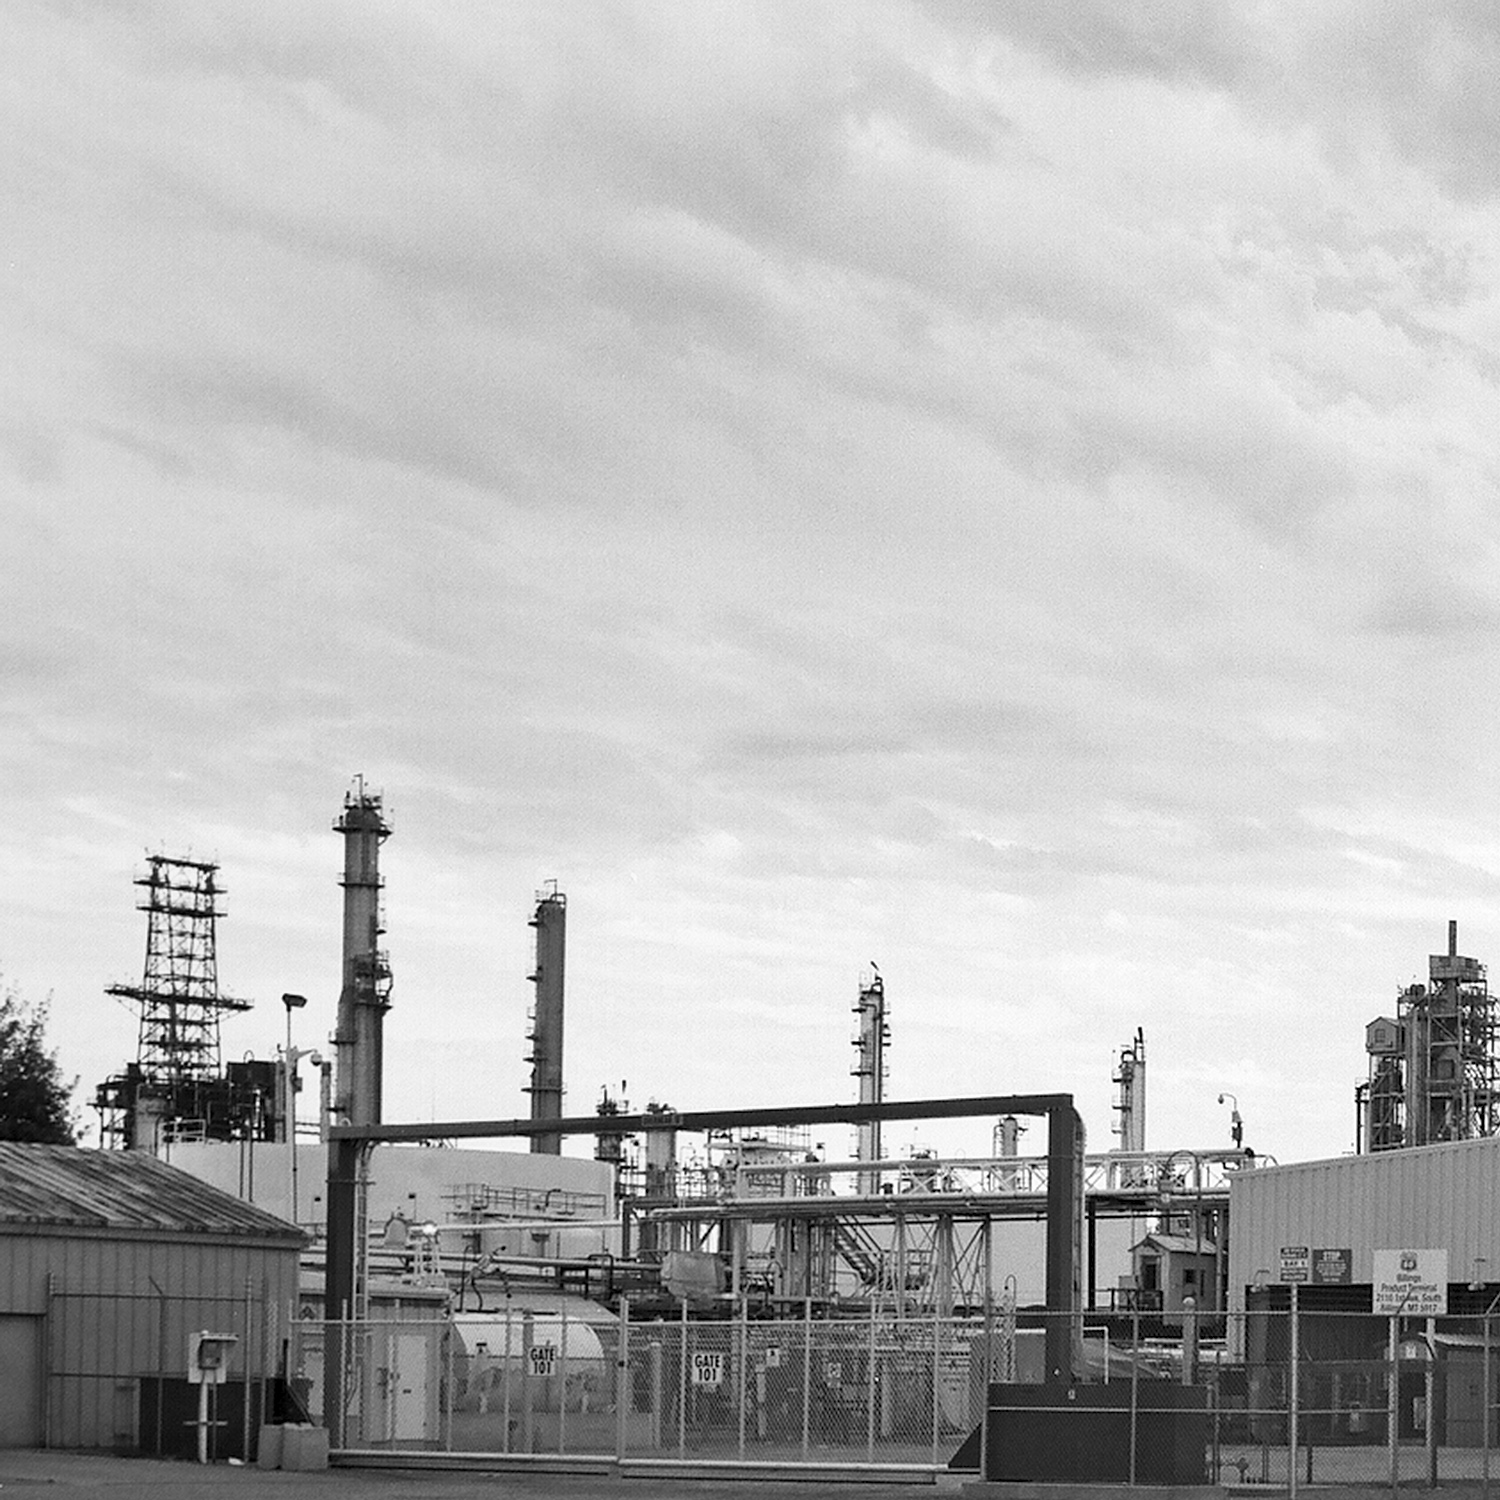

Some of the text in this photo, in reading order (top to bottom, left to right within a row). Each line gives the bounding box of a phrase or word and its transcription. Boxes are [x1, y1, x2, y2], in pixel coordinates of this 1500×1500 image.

[531, 1348, 554, 1361] GATE
[534, 1361, 551, 1374] 101
[695, 1355, 720, 1368] GATE
[699, 1368, 716, 1381] 101
